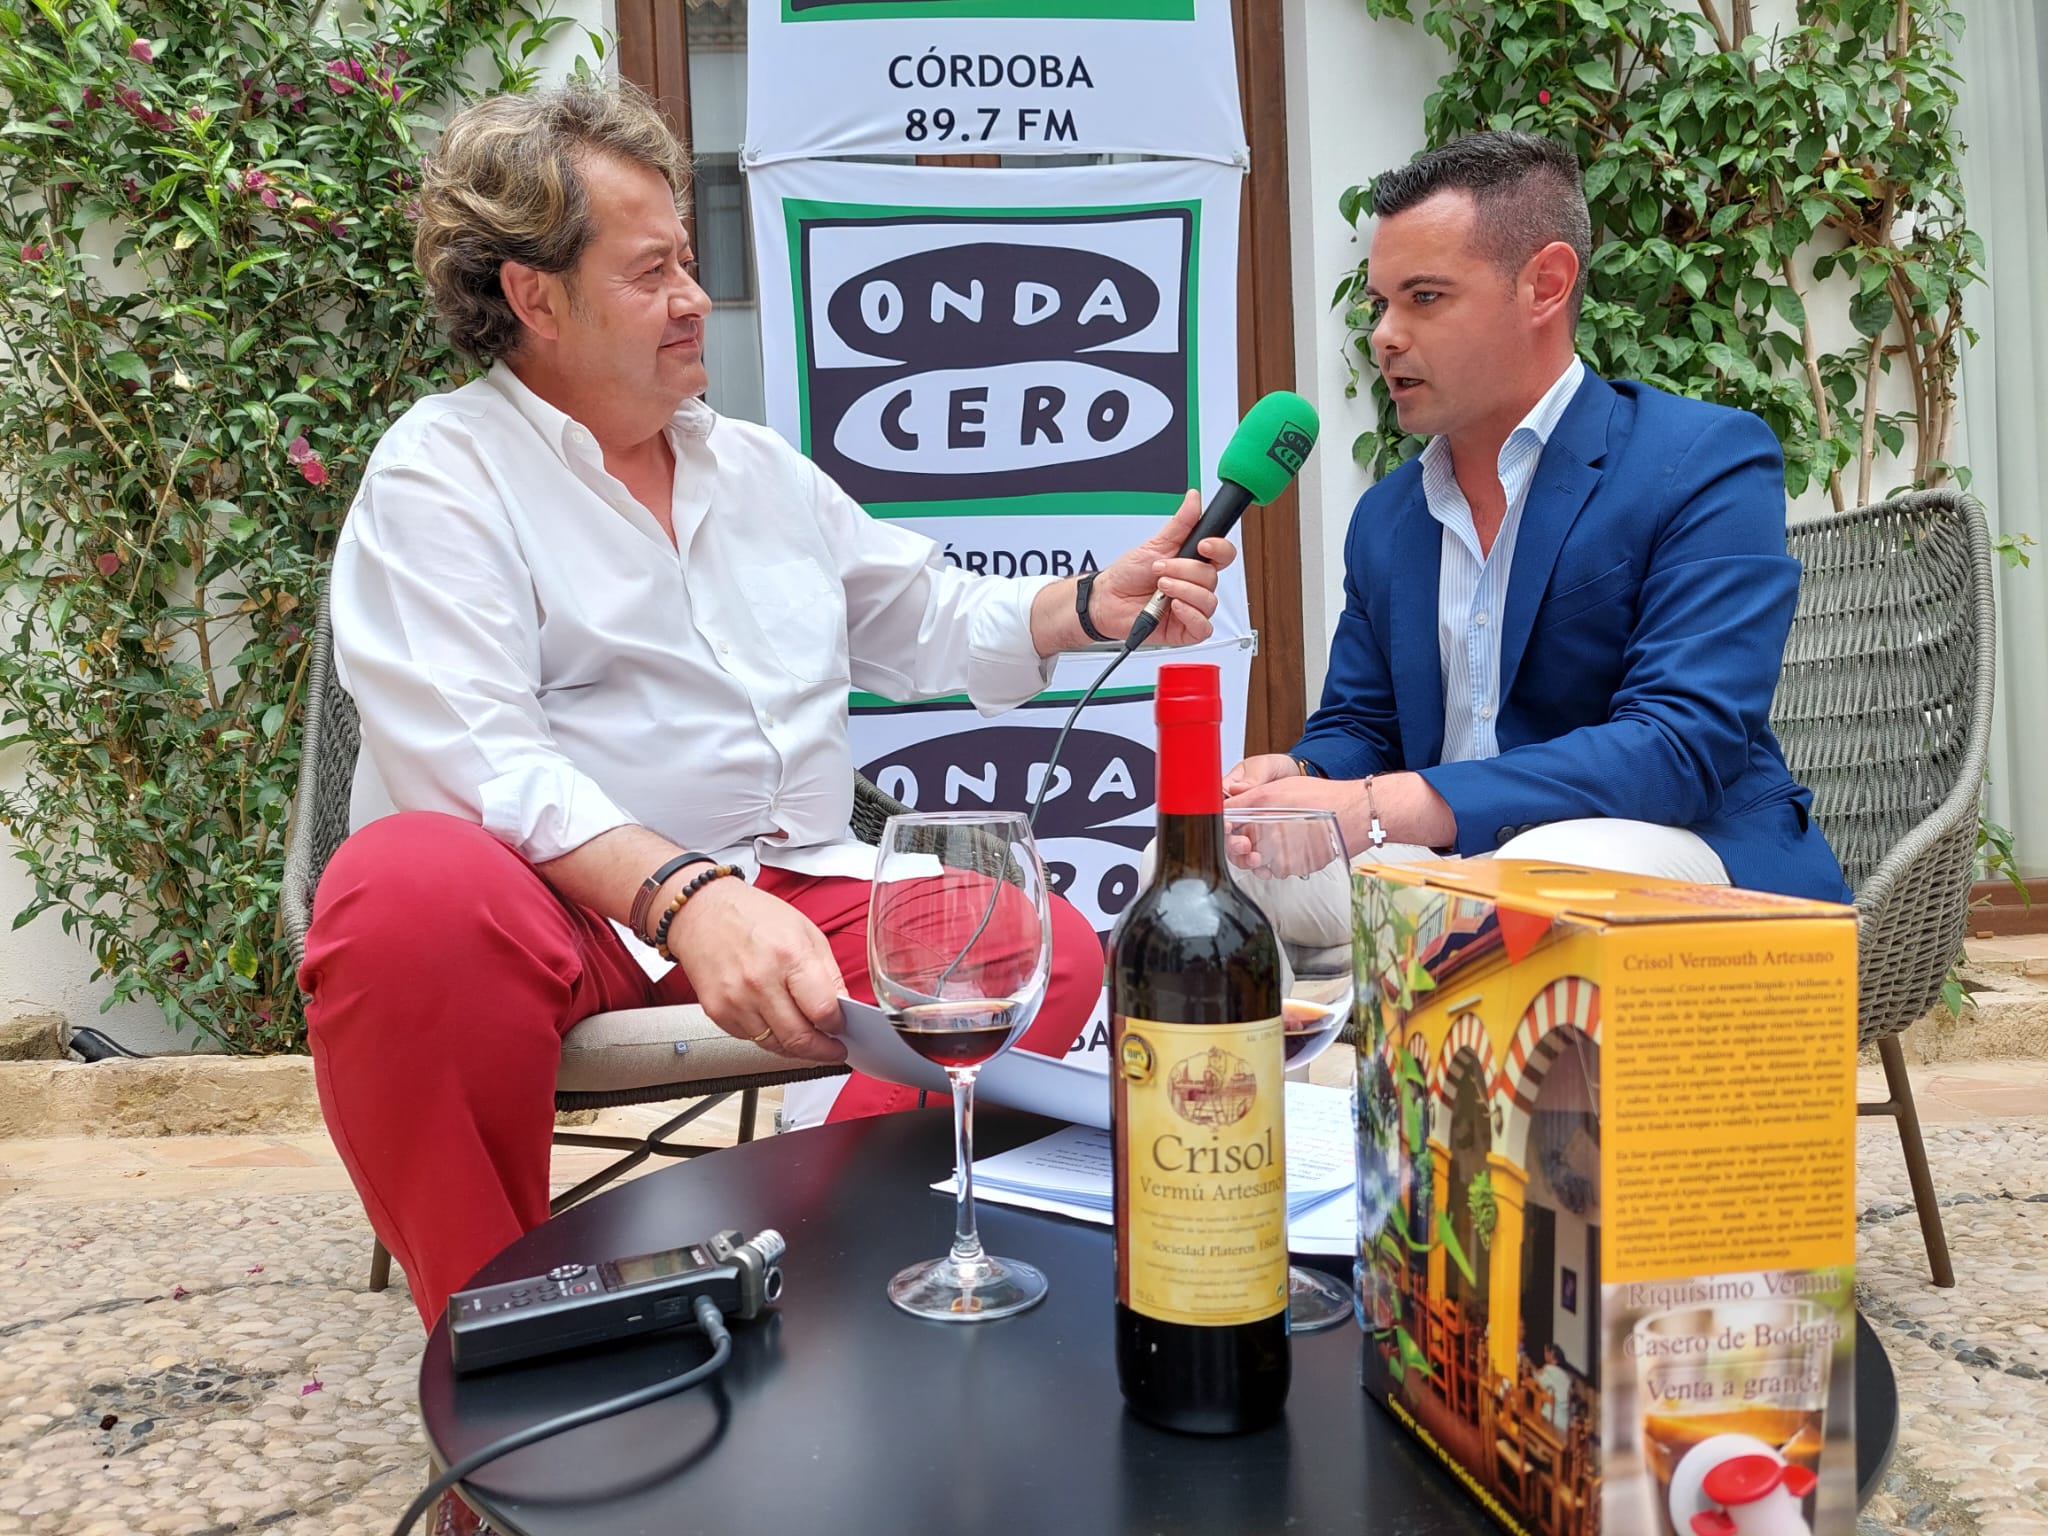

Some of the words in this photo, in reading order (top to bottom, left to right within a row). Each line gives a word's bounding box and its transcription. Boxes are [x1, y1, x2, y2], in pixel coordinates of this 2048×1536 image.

[888, 46, 1094, 89] CÓRDOBA
[905, 108, 1000, 142] 89.7
[1018, 109, 1078, 141] FM
[860, 278, 1128, 335] ONDA
[880, 385, 1130, 452] CERO
[876, 756, 1137, 809] ONDA
[1623, 954, 1674, 972] Crisol
[1679, 951, 1758, 970] Vermouth
[1764, 949, 1834, 967] Artesano
[1152, 1128, 1274, 1174] Crisol
[1140, 1174, 1204, 1201] Vermú
[1152, 1239, 1206, 1257] Sociedad
[1209, 1242, 1255, 1257] Plateros
[1628, 1276, 1754, 1310] Riquísimo
[1763, 1268, 1841, 1296] Vermú
[1625, 1333, 1709, 1358] Casero
[1717, 1326, 1745, 1350] de
[1754, 1321, 1842, 1349] Bodega
[1647, 1380, 1714, 1402] Venta
[1722, 1381, 1734, 1396] a
